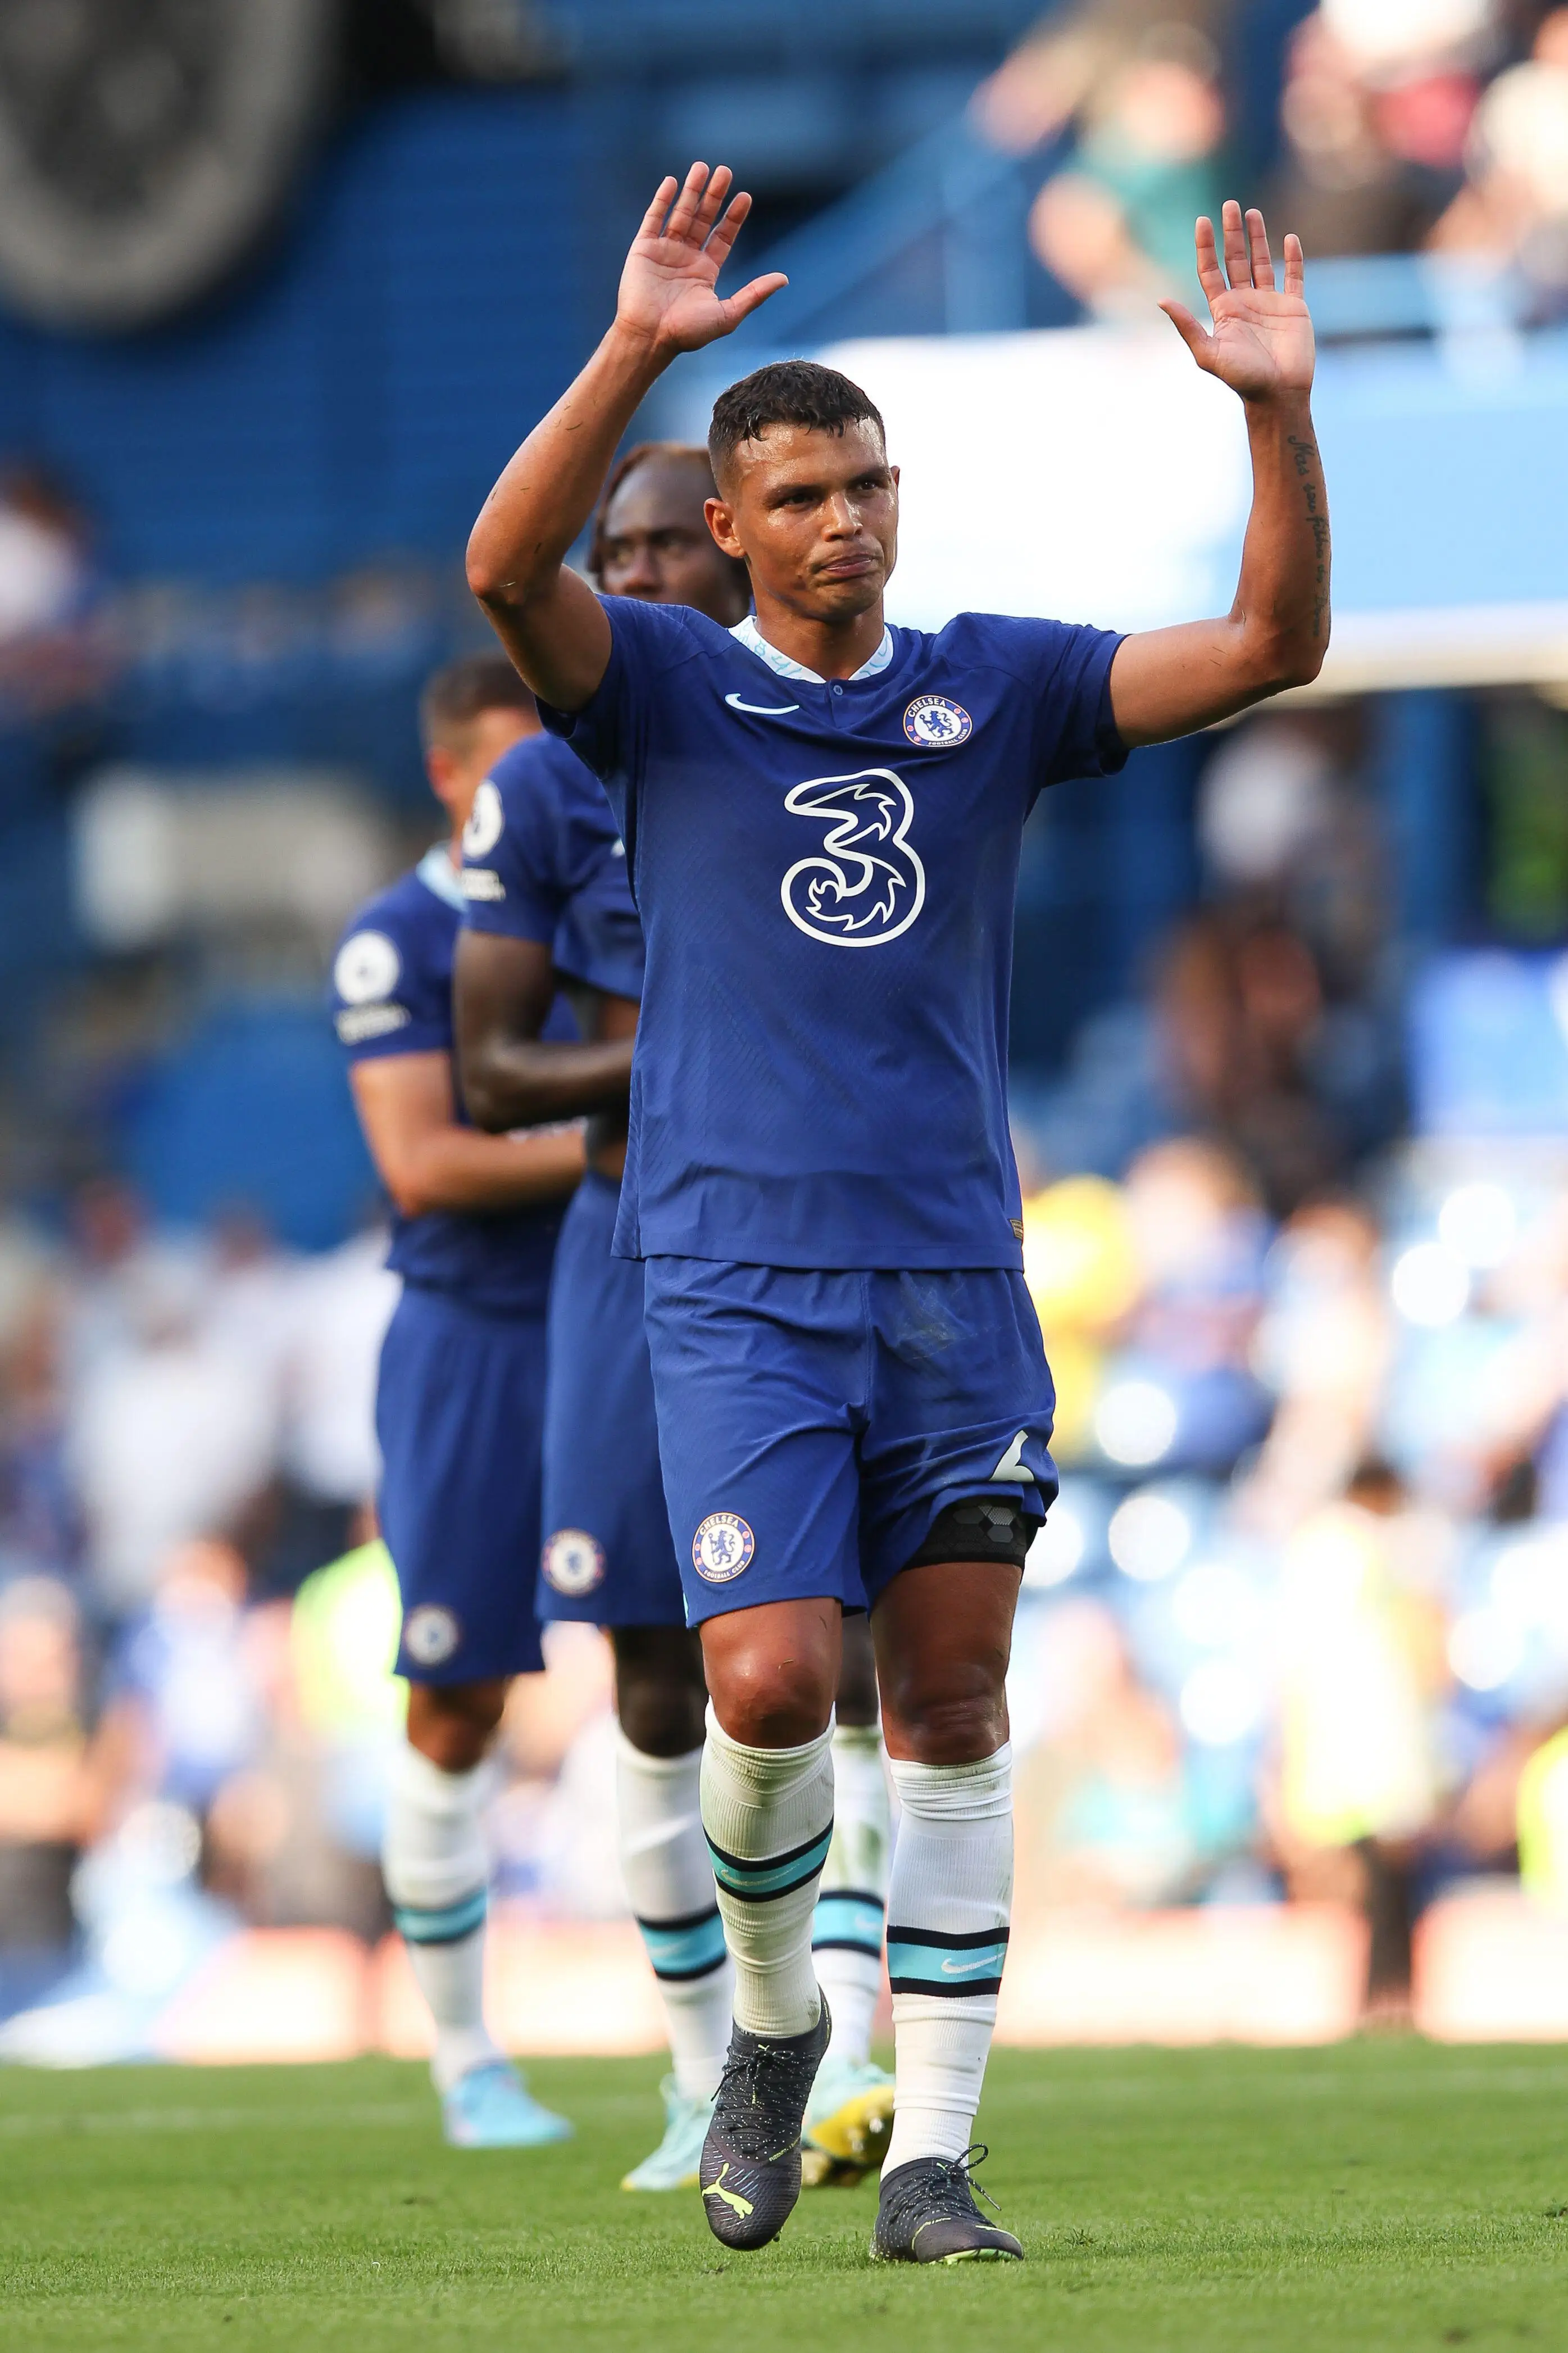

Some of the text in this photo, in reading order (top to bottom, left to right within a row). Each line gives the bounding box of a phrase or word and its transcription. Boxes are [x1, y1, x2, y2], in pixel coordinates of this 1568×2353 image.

[908, 697, 946, 718] CHELSEA
[781, 768, 925, 947] 3
[699, 1515, 739, 1535] CHELSEA
